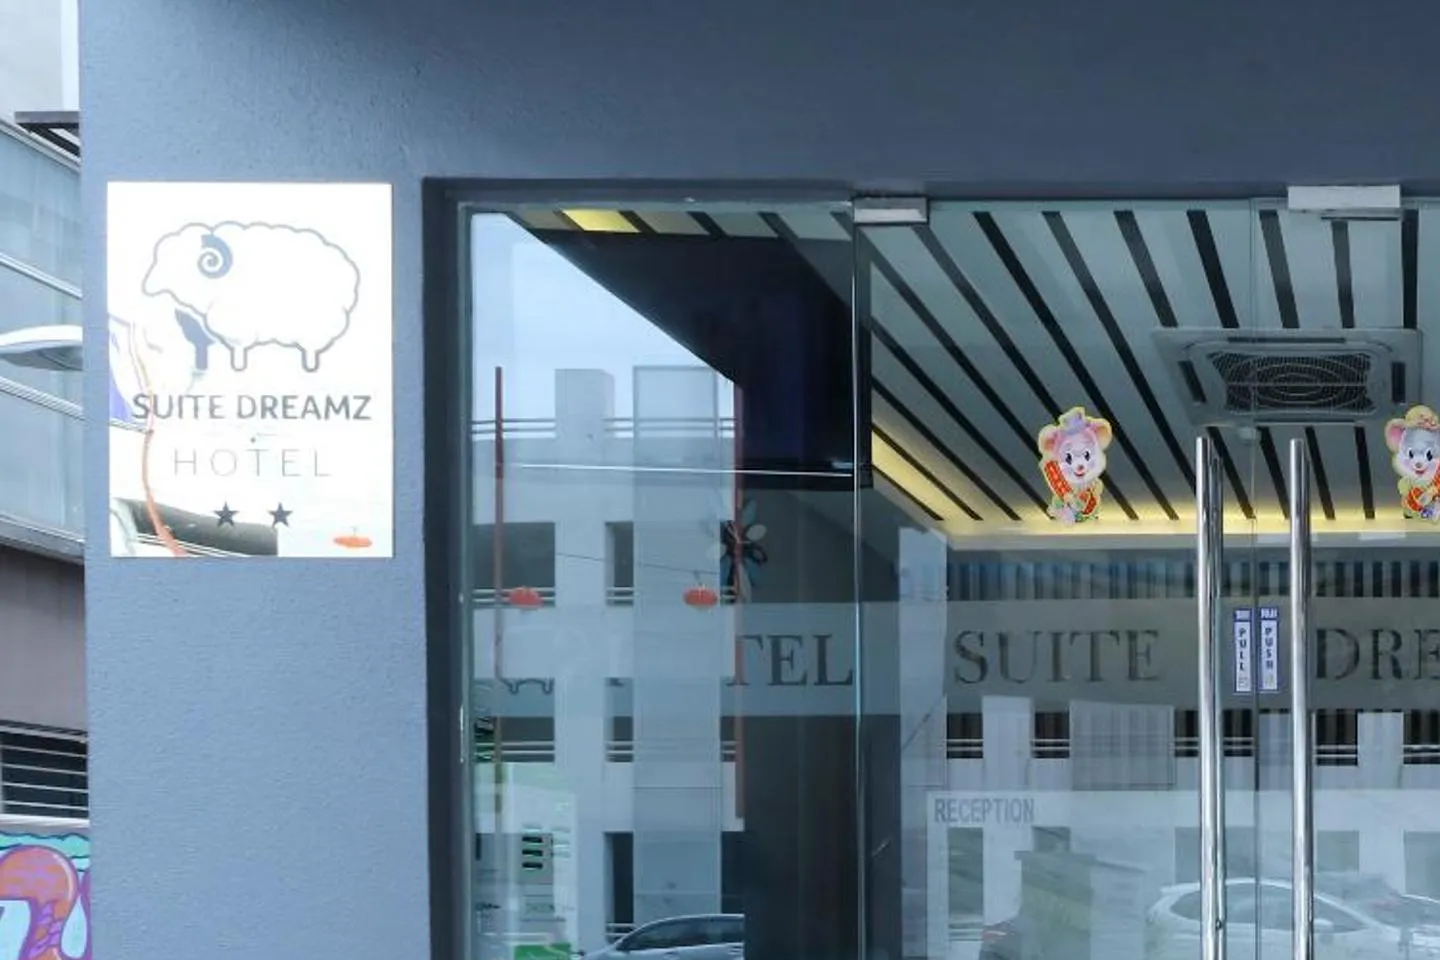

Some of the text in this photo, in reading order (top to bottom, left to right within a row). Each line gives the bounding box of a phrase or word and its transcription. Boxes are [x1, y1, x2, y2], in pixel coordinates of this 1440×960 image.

[133, 393, 373, 420] SUITE DREAMZ
[173, 448, 332, 477] HOTEL
[953, 629, 1160, 684] SUITE
[934, 798, 1034, 823] RECEPTION
